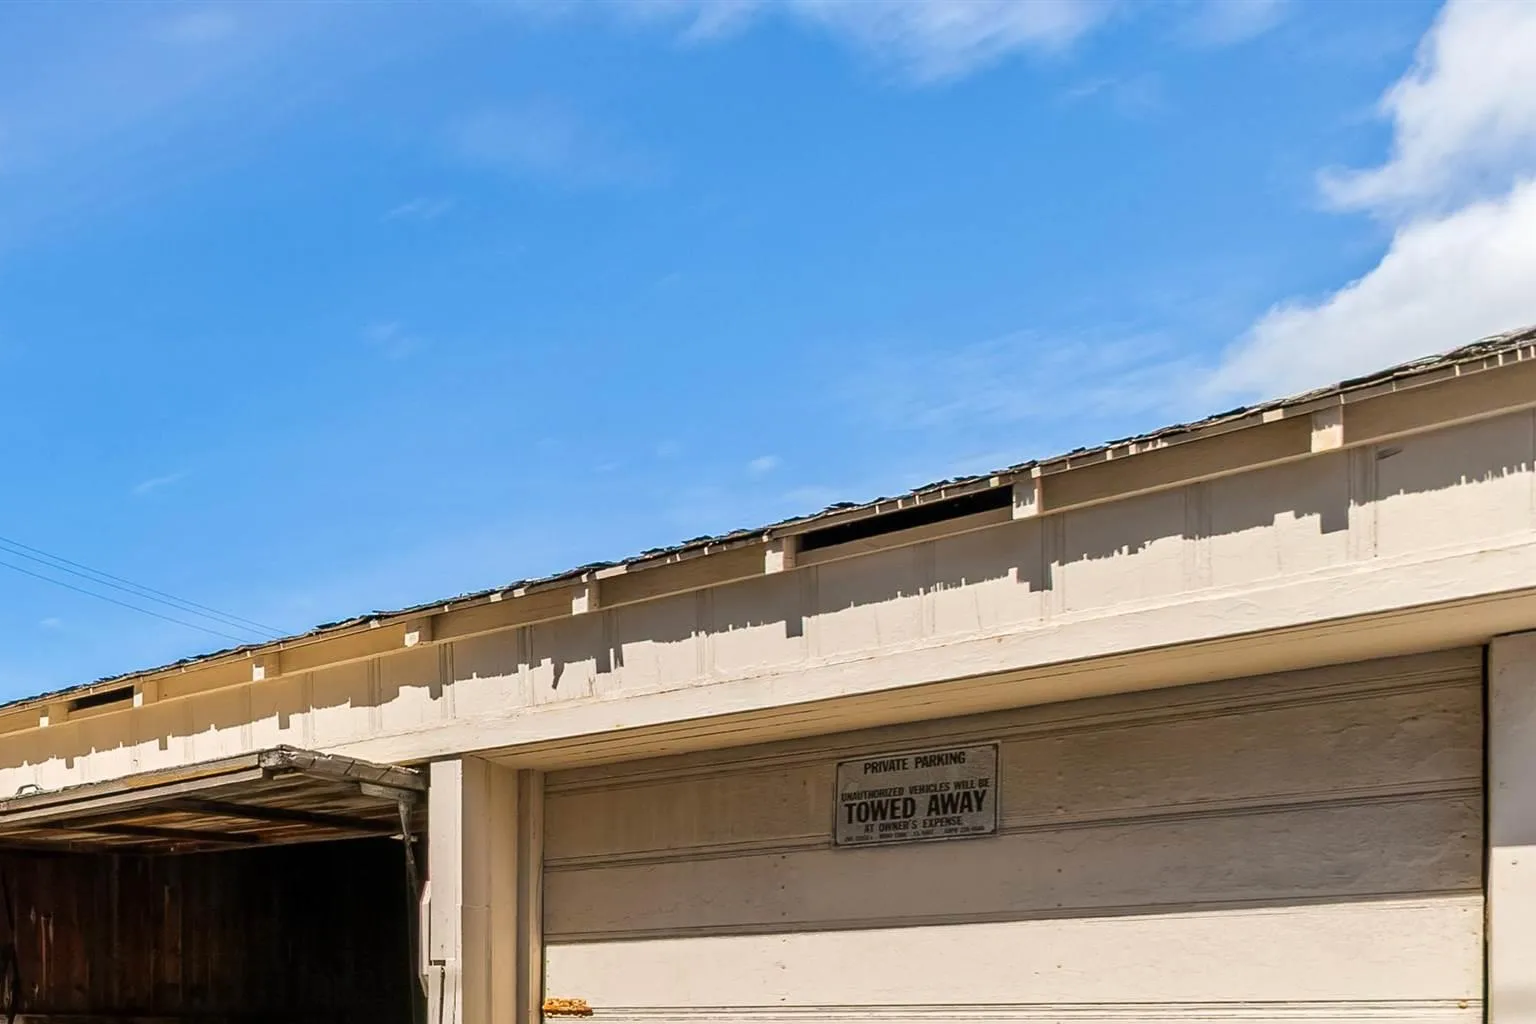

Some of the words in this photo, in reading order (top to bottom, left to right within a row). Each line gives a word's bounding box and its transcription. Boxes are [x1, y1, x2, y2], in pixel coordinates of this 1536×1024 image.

[864, 758, 909, 775] PRIVATE
[915, 751, 966, 769] PARKING
[841, 786, 905, 802] UNAUTHORIZED
[909, 781, 951, 796] VEHICLES
[954, 779, 976, 791] WILL
[978, 777, 991, 789] BE
[844, 797, 916, 825] TOWED
[927, 789, 988, 817] AWAY
[864, 825, 874, 834] AT
[878, 819, 918, 833] OWNER'S
[922, 815, 964, 829] EXPENSE
